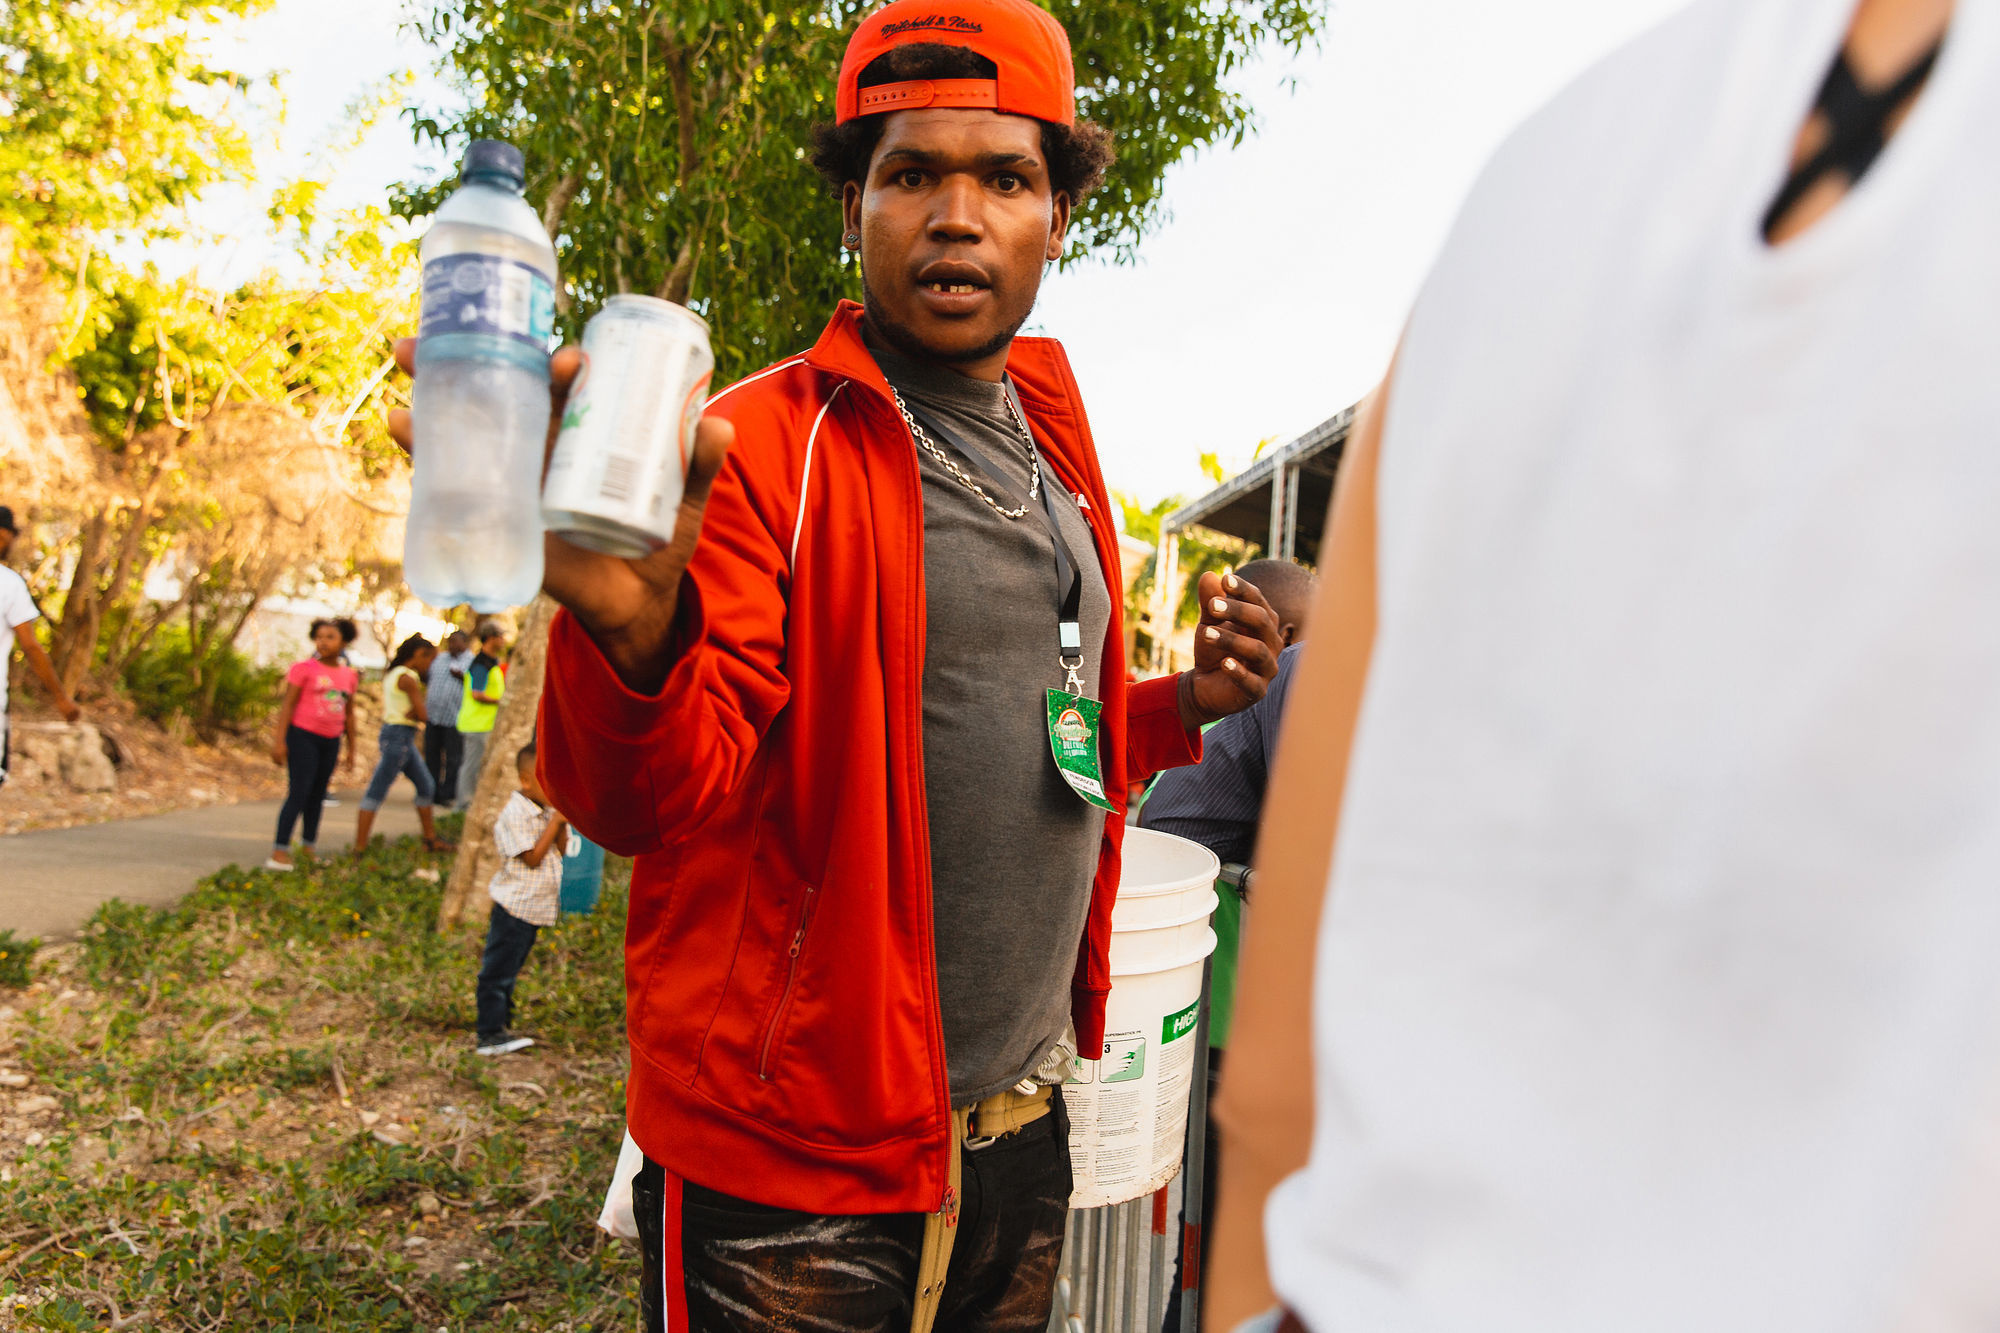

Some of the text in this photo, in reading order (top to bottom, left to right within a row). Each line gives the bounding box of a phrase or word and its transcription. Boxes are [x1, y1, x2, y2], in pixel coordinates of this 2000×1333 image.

[881, 15, 984, 36] Mitchell & Ness
[1104, 1043, 1111, 1054] 3
